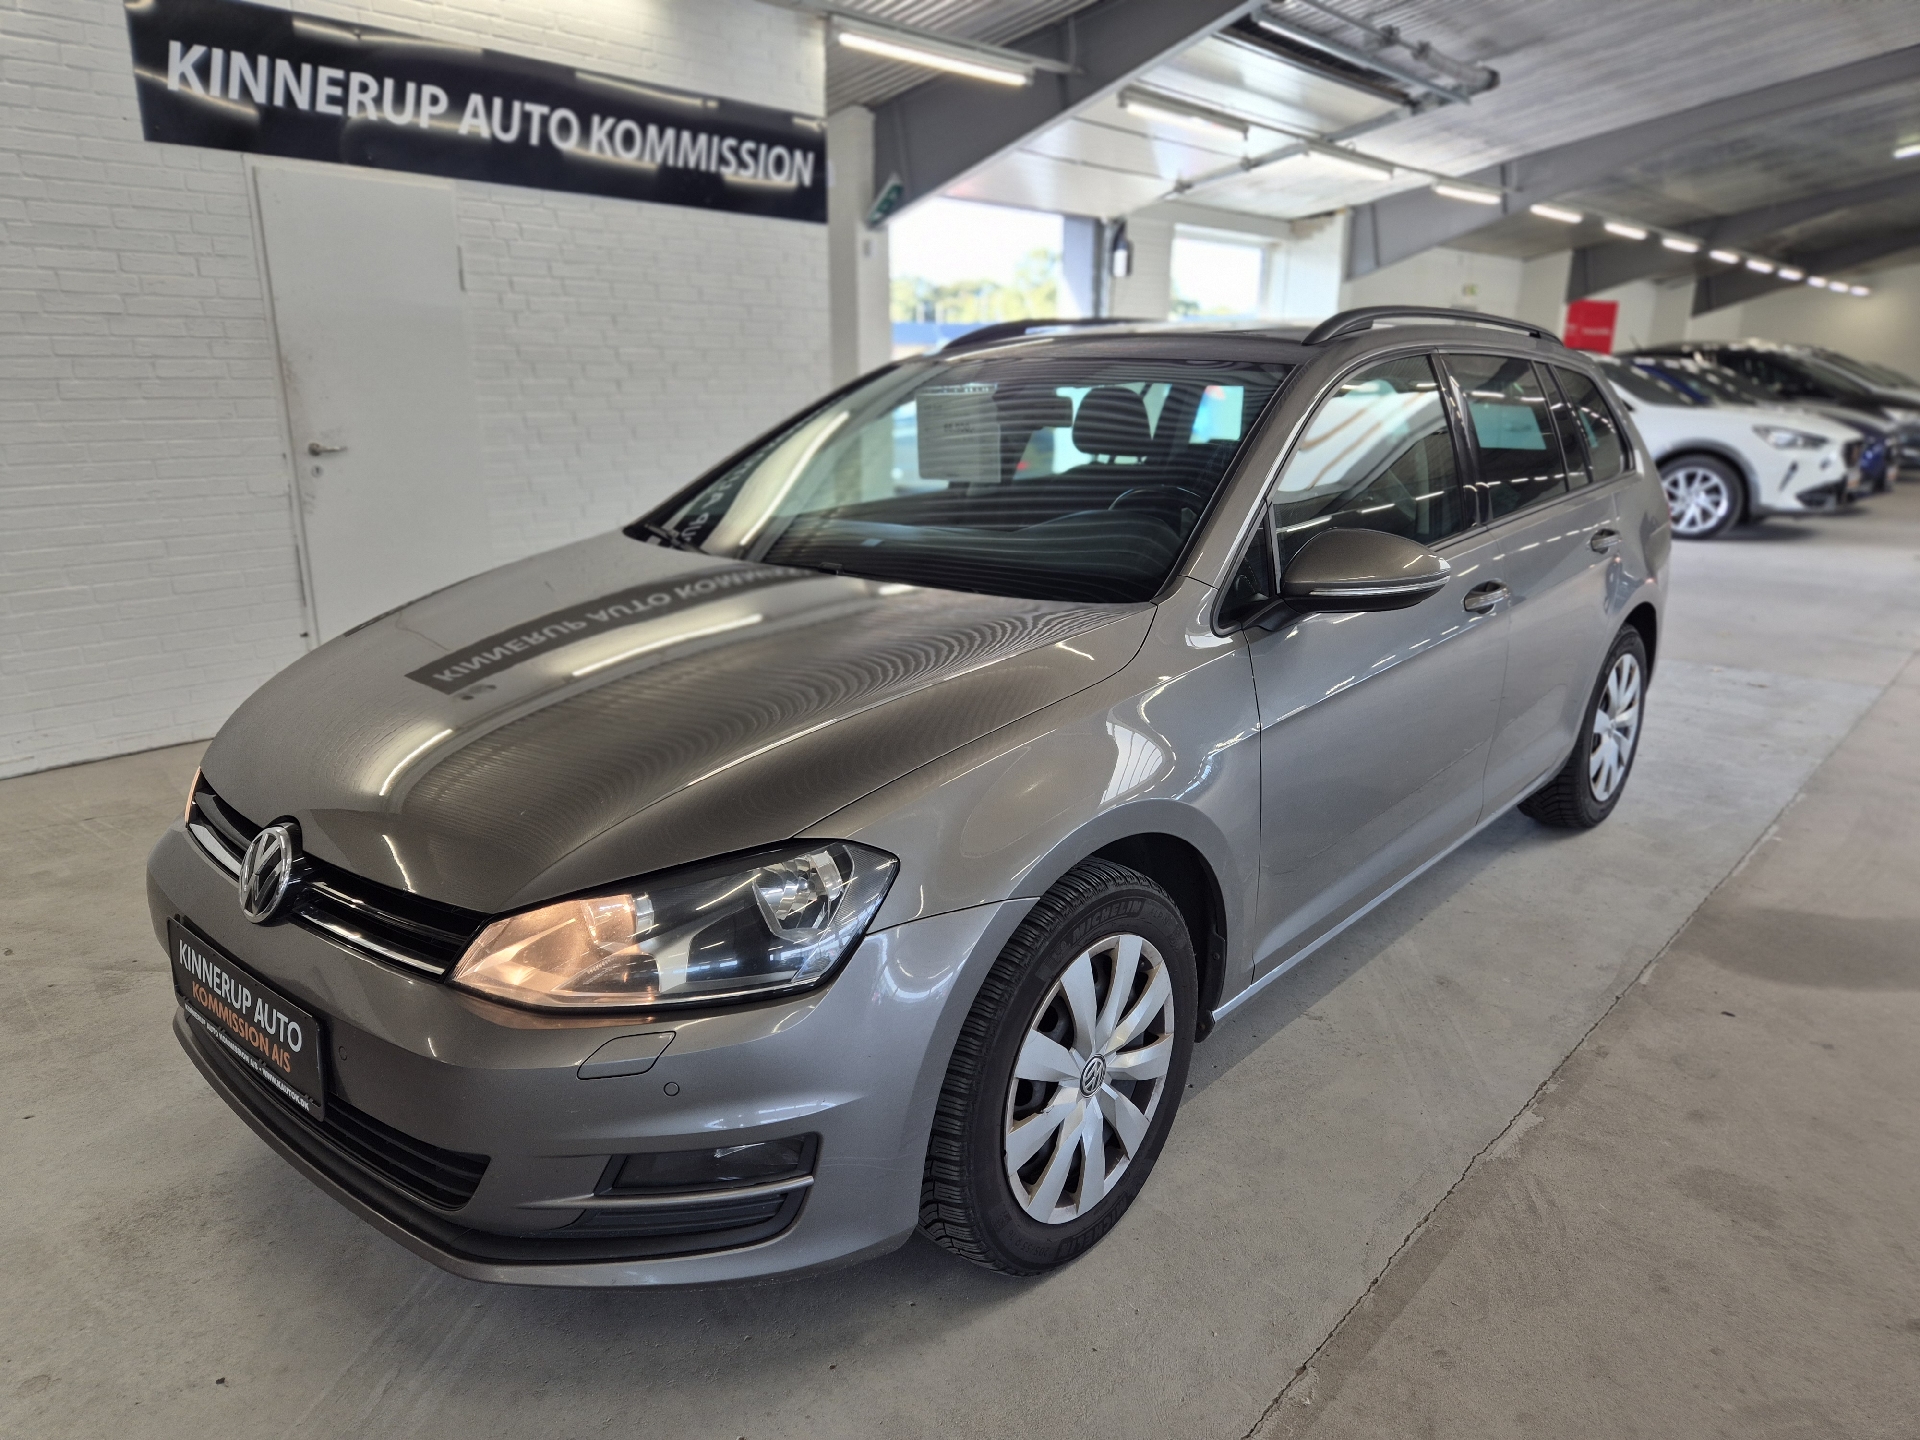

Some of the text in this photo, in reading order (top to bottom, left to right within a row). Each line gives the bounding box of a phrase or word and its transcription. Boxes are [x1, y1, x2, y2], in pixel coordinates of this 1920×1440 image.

[167, 40, 815, 188] KINNERUP AUTO KOMMISSION
[1072, 900, 1142, 943] MICHELIN
[180, 939, 302, 1052] KINNERUP AUTO
[192, 981, 269, 1057] KOMMISSION
